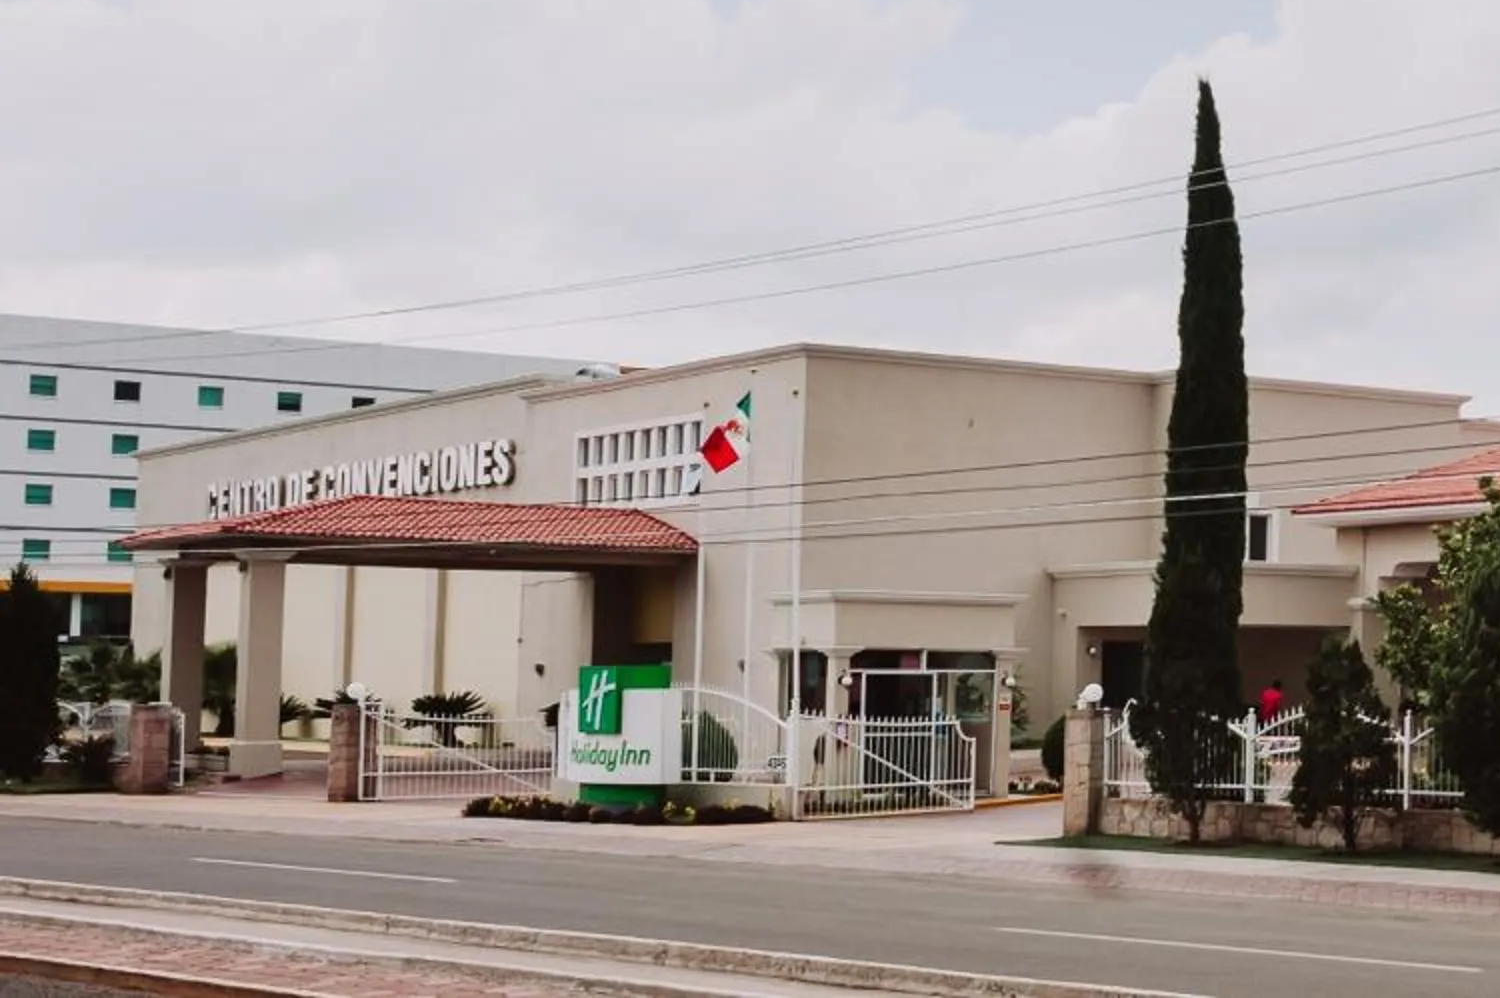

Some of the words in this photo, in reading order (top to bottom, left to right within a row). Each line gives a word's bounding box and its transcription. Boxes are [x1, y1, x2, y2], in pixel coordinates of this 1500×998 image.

[208, 476, 279, 520] CENTRO
[287, 469, 320, 506] DE
[319, 439, 516, 499] CONVENCIONES
[619, 739, 651, 766] Inn
